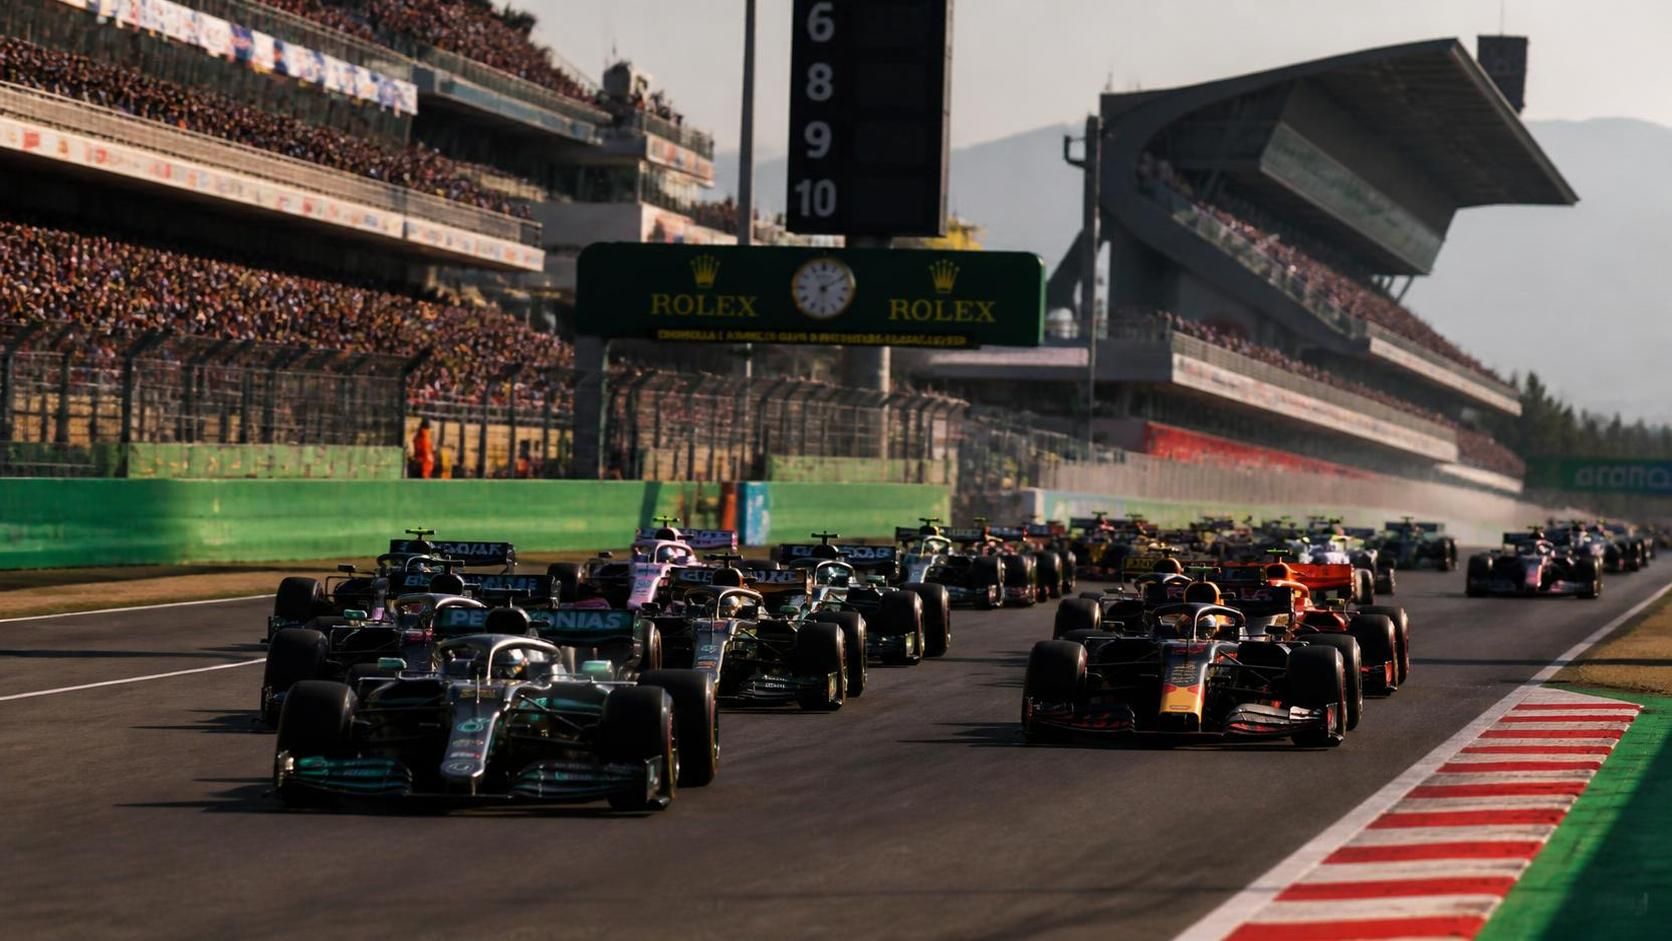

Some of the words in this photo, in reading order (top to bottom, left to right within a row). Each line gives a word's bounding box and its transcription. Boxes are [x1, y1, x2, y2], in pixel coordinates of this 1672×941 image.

[807, 1, 835, 43] 6
[806, 62, 834, 101] 8
[804, 120, 832, 159] 9
[794, 178, 837, 217] 10
[650, 293, 759, 318] ROLEX
[888, 298, 997, 323] ROLEX
